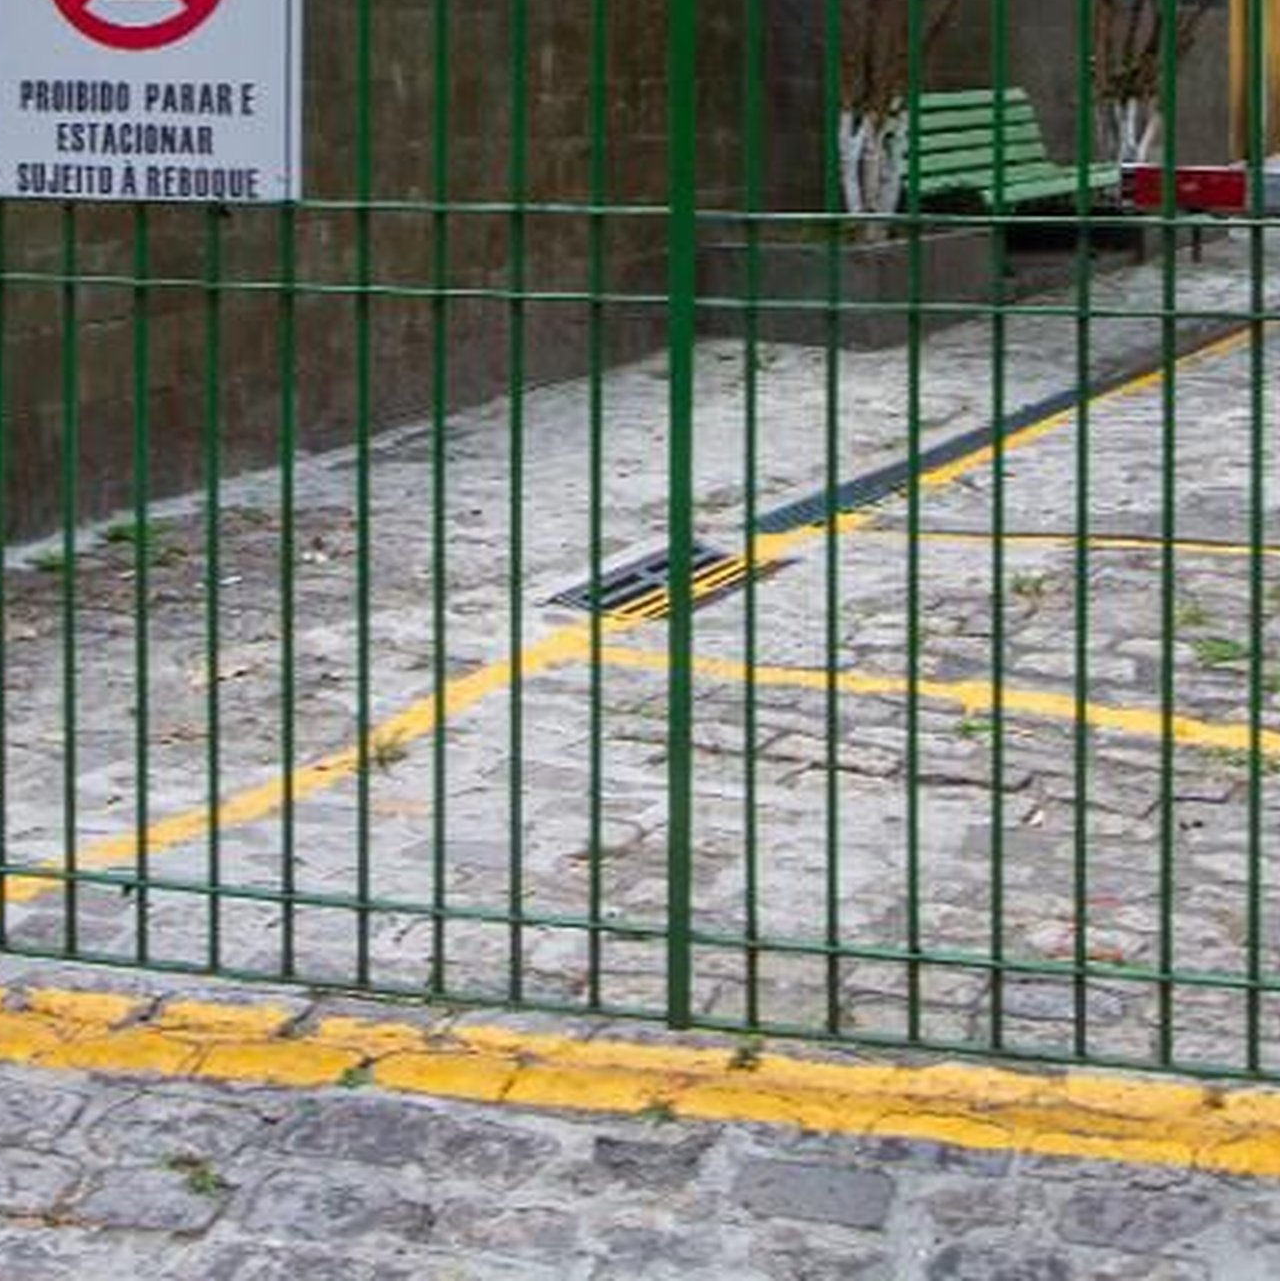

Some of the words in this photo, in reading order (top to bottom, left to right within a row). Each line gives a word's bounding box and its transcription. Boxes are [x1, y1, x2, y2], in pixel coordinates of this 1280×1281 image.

[20, 79, 131, 114] PROIBIDO
[145, 82, 233, 116] PARAR
[240, 82, 257, 116] E
[56, 122, 214, 155] ESTACIONAR
[17, 162, 113, 195] SUJEITO
[146, 165, 261, 198] REBOQUE
